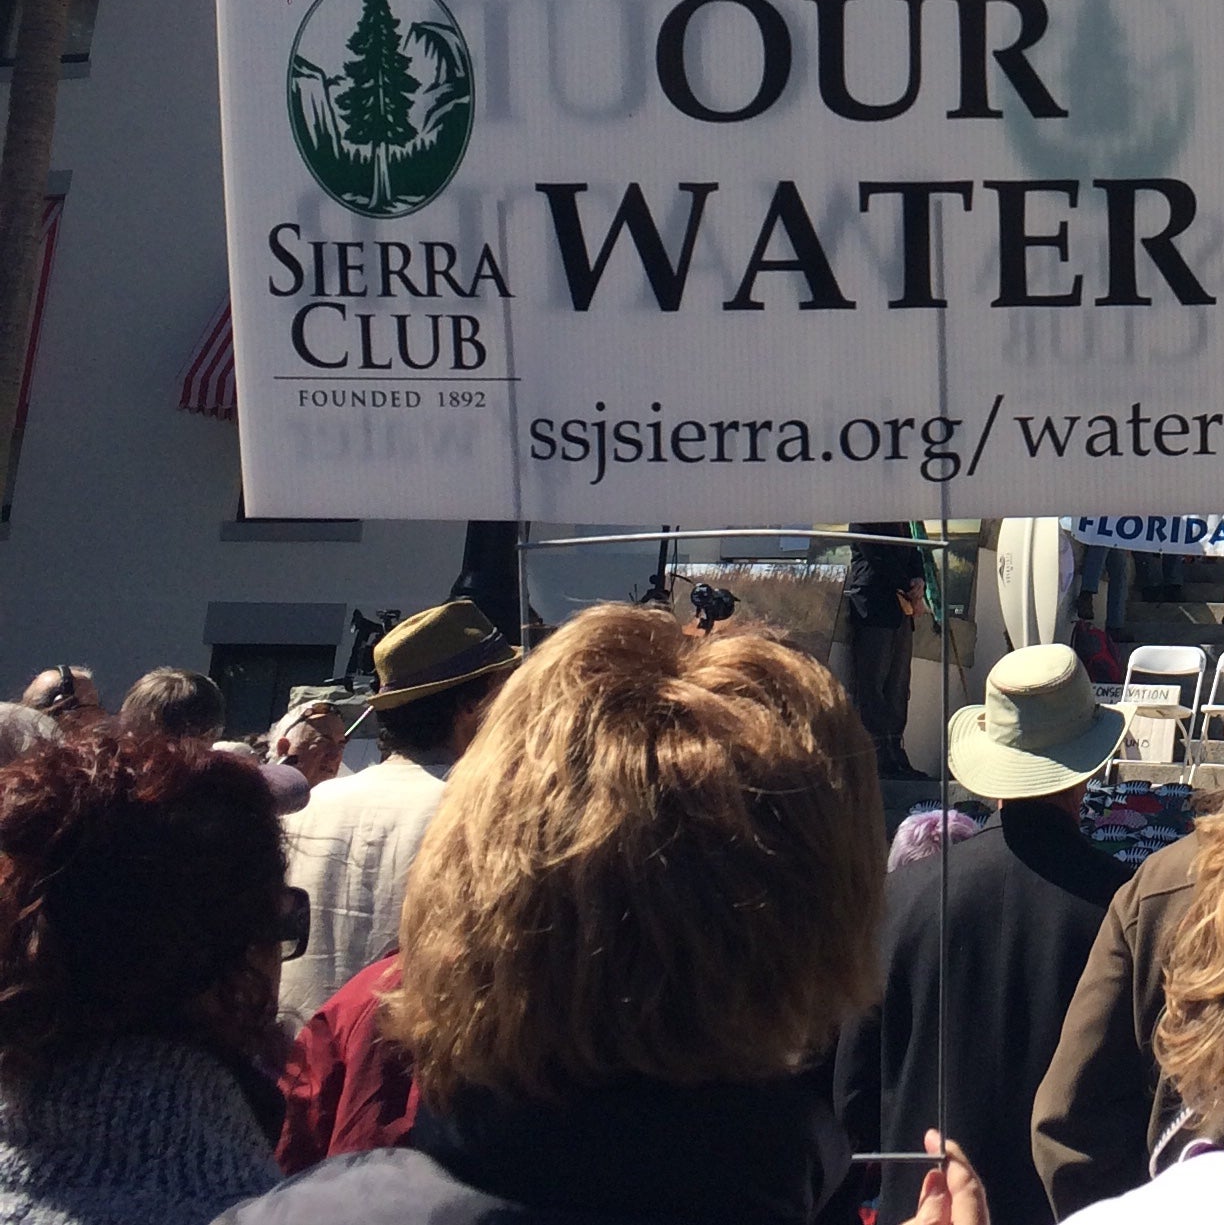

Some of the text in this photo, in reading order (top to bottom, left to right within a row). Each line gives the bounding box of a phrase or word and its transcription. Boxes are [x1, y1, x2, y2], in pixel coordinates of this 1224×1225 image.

[267, 222, 515, 300] SIERRA
[536, 177, 1217, 313] WATER
[290, 303, 488, 371] CLUB
[298, 387, 487, 408] FOUNDED 1892
[1093, 686, 1169, 700] ONSEVATION
